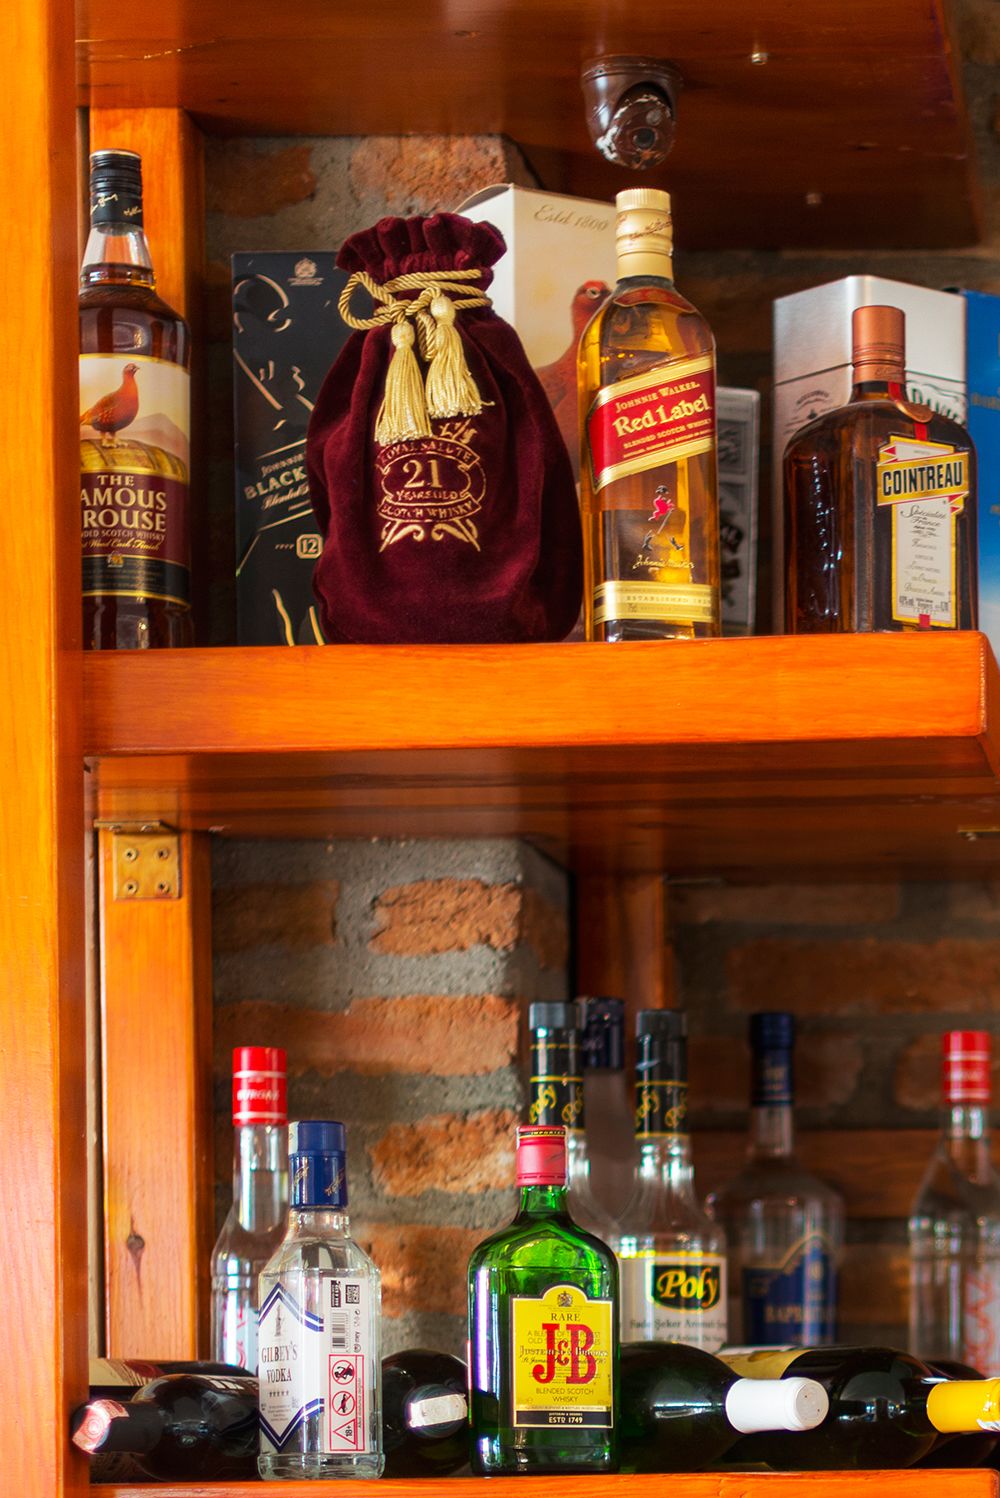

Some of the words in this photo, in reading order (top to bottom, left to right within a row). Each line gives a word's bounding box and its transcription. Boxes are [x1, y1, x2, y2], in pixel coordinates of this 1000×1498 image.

[612, 409, 658, 438] Red
[655, 393, 713, 425] Label
[616, 393, 659, 414] JOHNNIE
[657, 425, 687, 439] SCOTCH
[97, 475, 135, 487] THE
[244, 466, 307, 500] BLACK
[402, 459, 443, 489] 21
[882, 461, 964, 496] COINTREAU
[80, 487, 168, 512] AMOUS
[83, 508, 167, 532] ROUSE
[302, 538, 318, 554] 12
[656, 1266, 720, 1308] Poly
[551, 1312, 581, 1322] RARE
[261, 1340, 298, 1364] GILBEY'S
[532, 1323, 597, 1385] J&B
[267, 1367, 292, 1384] VODKA
[568, 1416, 583, 1424] 1749
